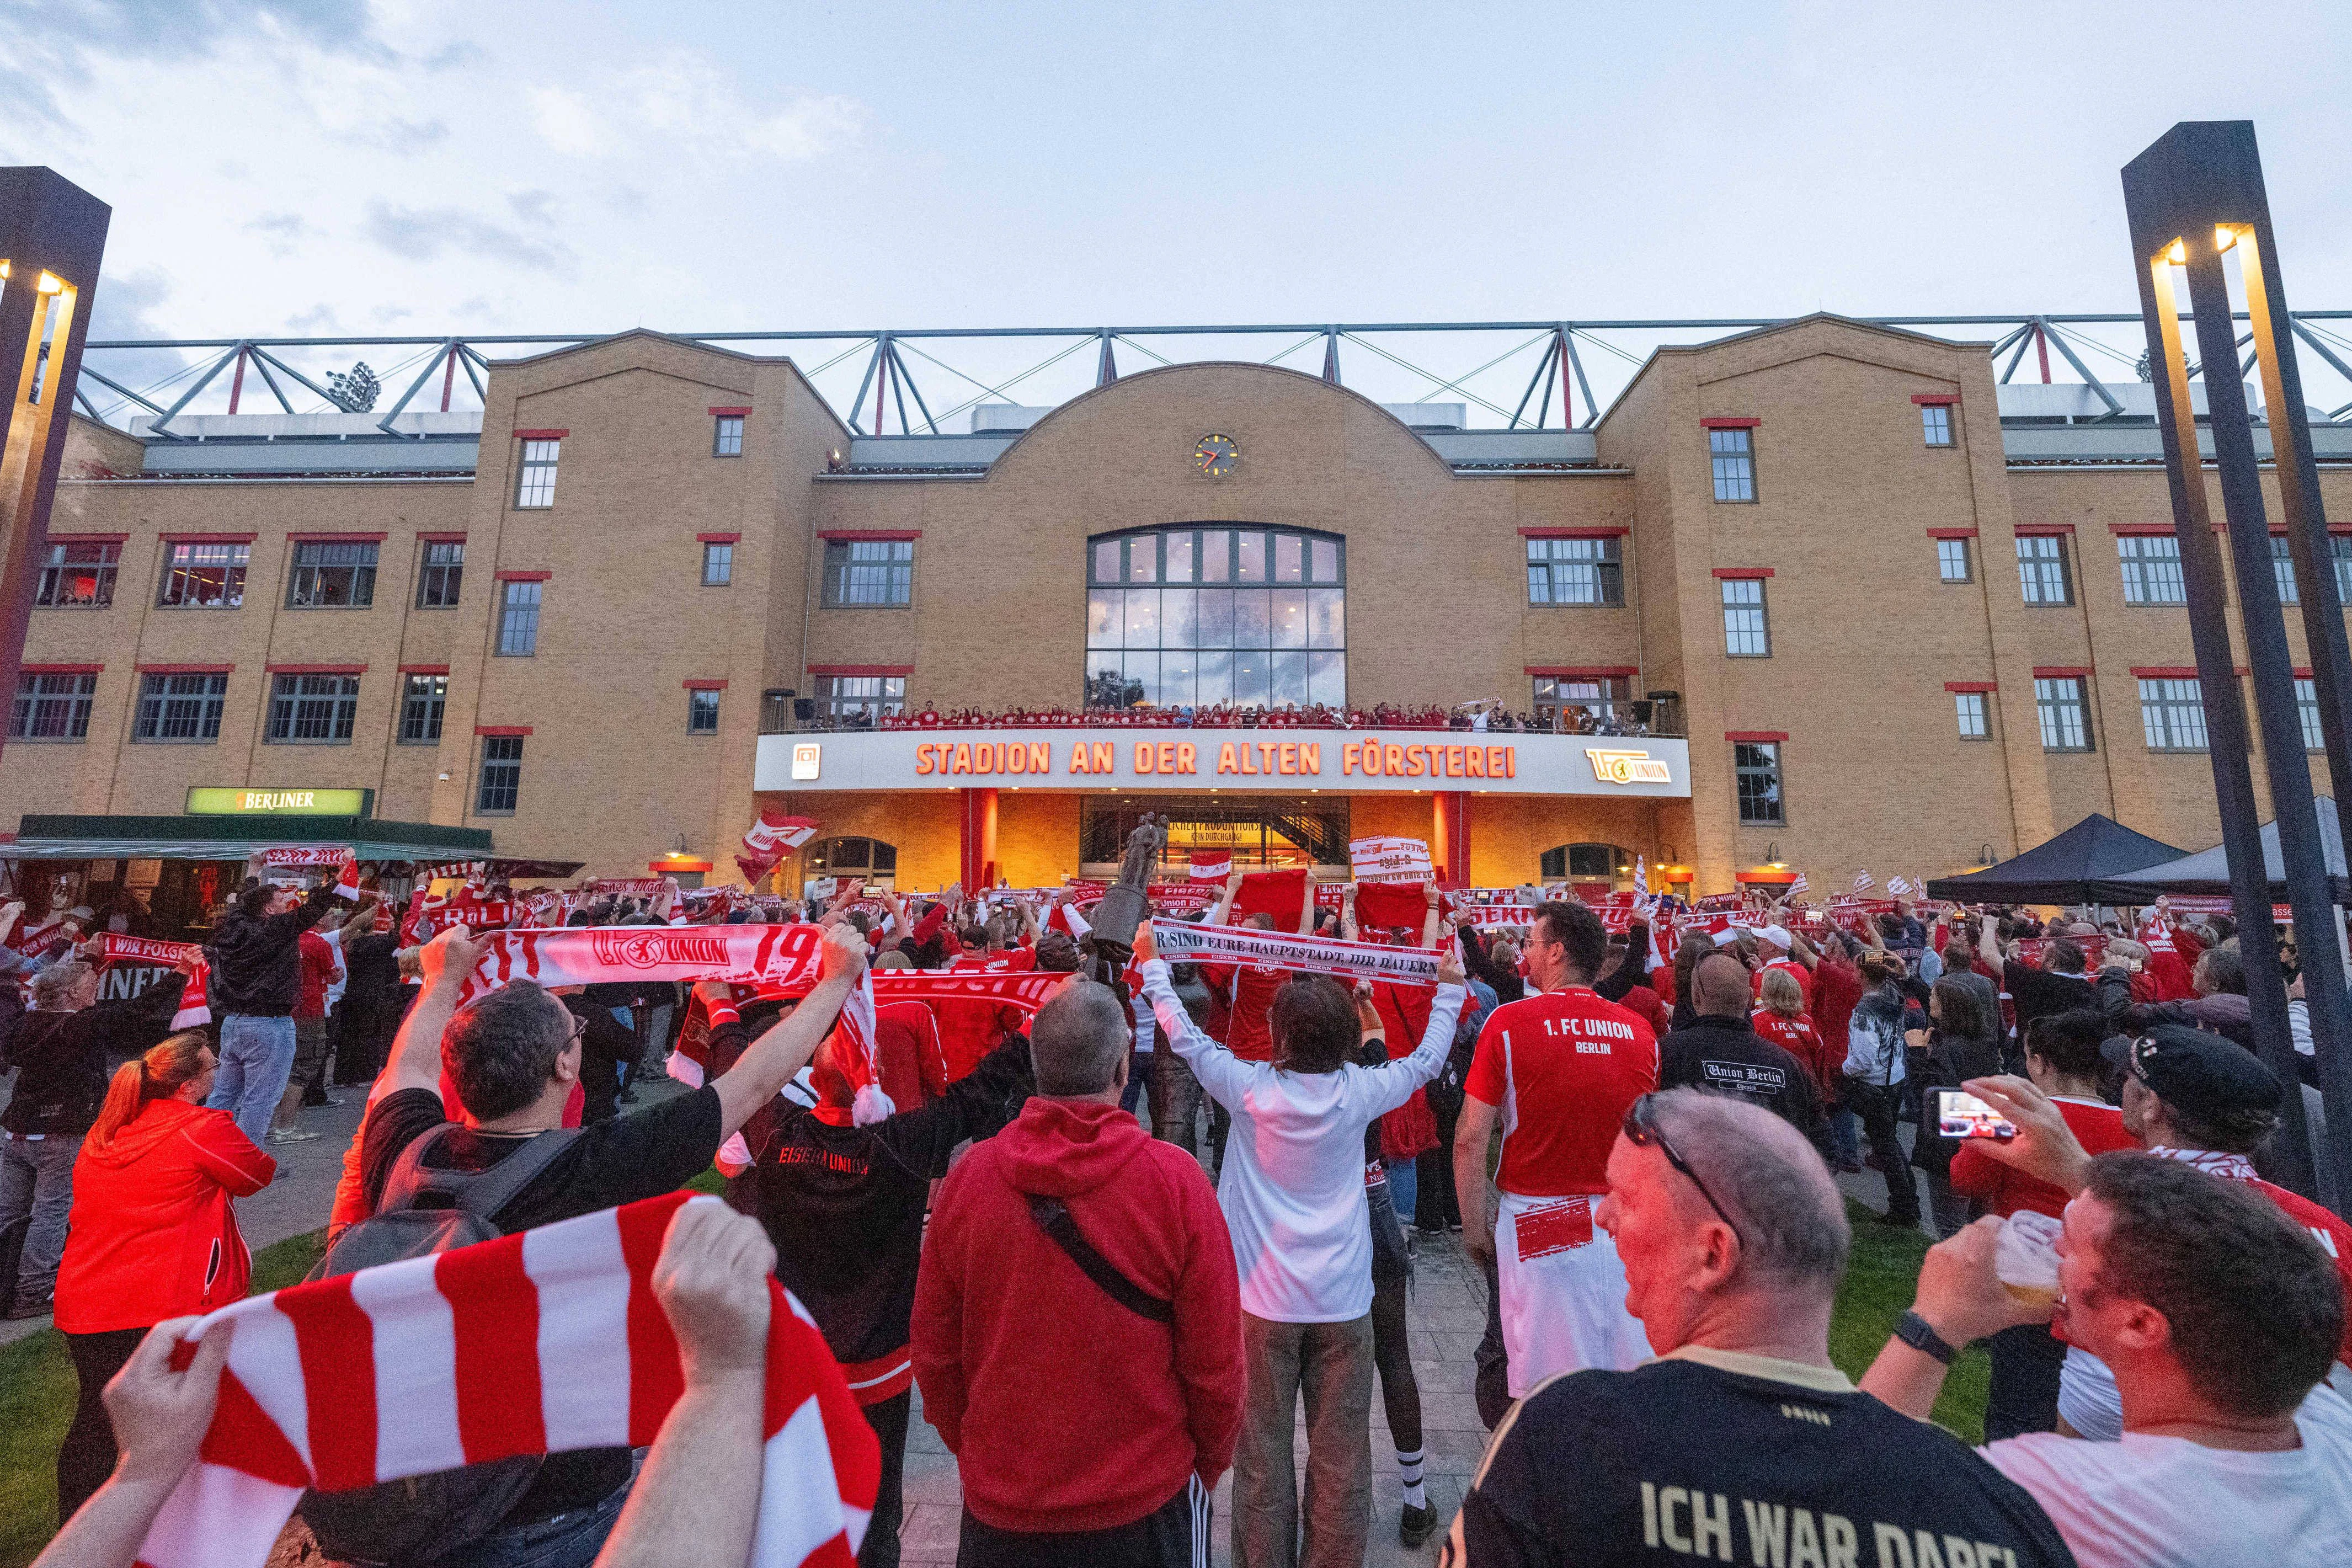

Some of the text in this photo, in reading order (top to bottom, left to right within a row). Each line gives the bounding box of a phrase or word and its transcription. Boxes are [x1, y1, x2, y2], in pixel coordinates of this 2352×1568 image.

[916, 738, 1516, 777] STADION AN DER ALTEN FÖRSTEREI
[1635, 763, 1667, 778] UNION
[245, 792, 314, 810] BERLINER
[1191, 832, 1204, 841] KEIN
[1161, 899, 1186, 908] Union
[2271, 907, 2292, 916] asse
[115, 938, 140, 954] WIR
[667, 938, 728, 963] UNION
[754, 926, 824, 981] 19
[1170, 932, 1203, 947] SIND
[1208, 937, 1245, 952] EURE
[1250, 941, 1345, 965] HAUPTSTADT,
[1399, 975, 1426, 984] EISERN
[1544, 1018, 1635, 1040] 1. FC UNION
[1771, 1022, 1778, 1031] 1.
[1778, 1022, 1787, 1031] FC
[1575, 1042, 1612, 1054] BERLIN
[1708, 1064, 1782, 1083] Union Berlin
[1640, 1481, 2017, 1568] ICH WAR DAB
